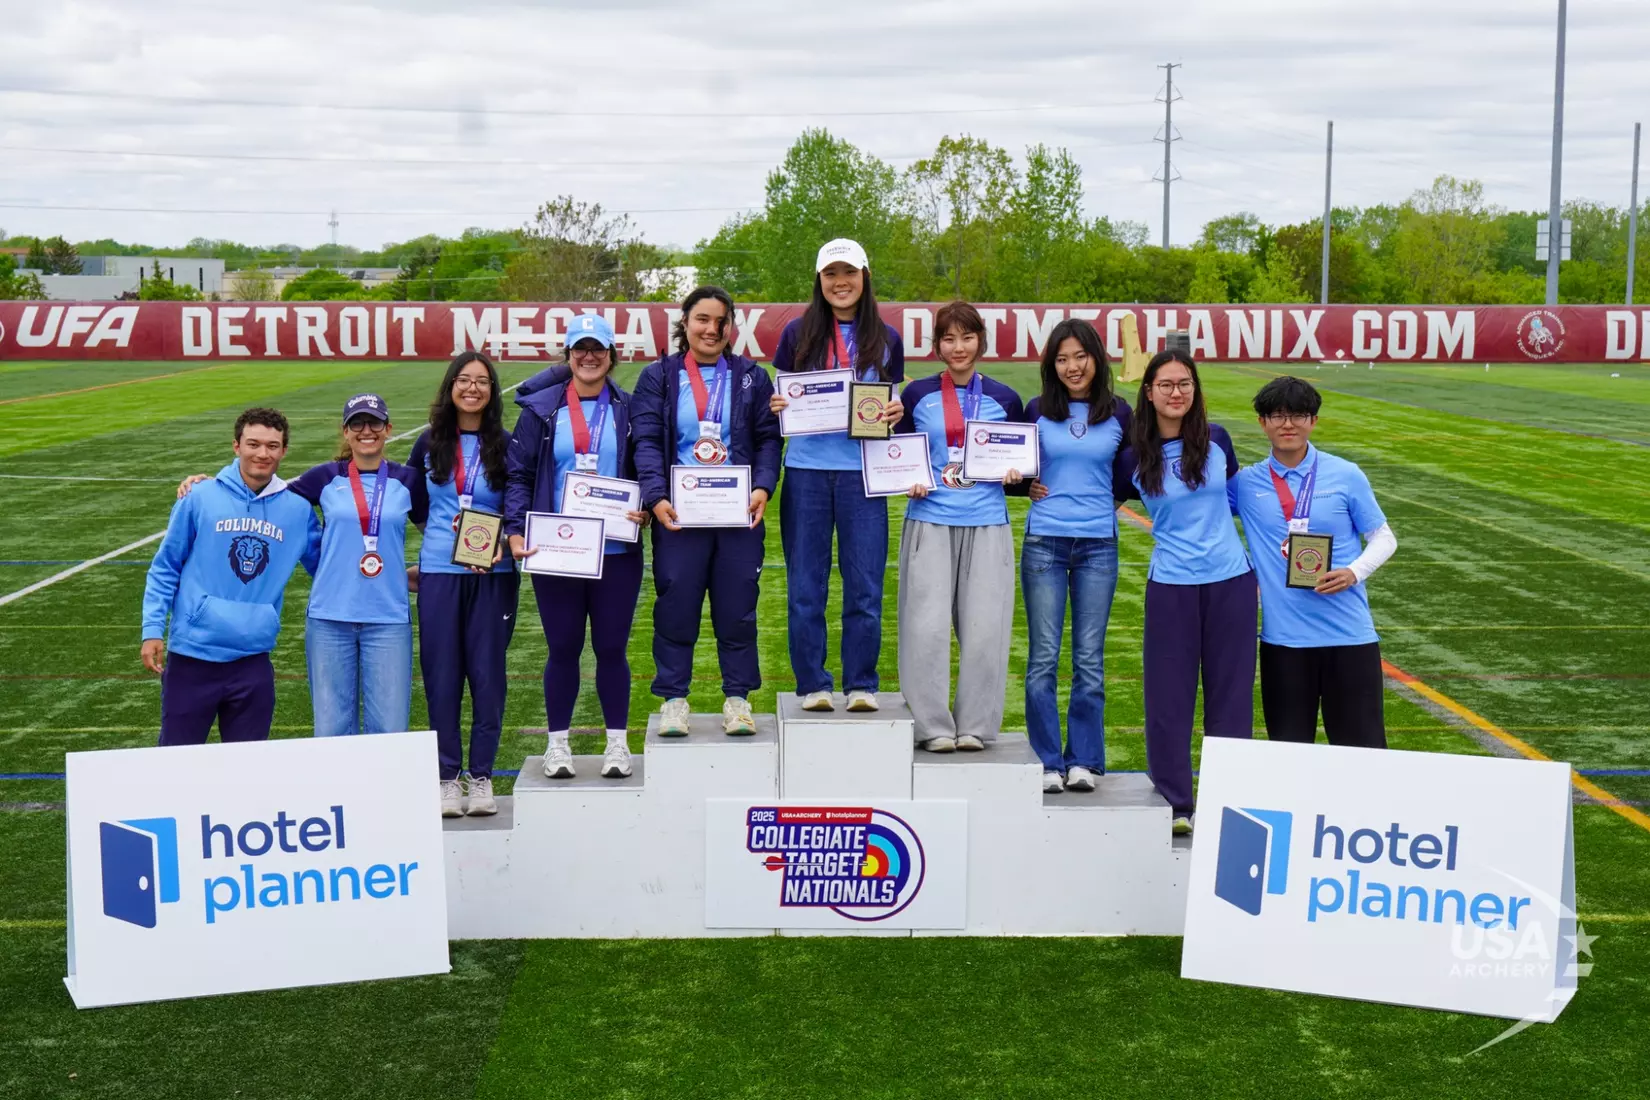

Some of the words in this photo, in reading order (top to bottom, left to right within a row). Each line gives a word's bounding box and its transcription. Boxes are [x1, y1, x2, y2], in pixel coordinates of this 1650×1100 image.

[15, 305, 140, 347] UFA
[181, 306, 425, 357] DETROIT
[582, 317, 594, 330] C
[1517, 311, 1542, 334] ADVANCED
[1543, 311, 1565, 334] TRAINING
[1605, 310, 1650, 360] D
[216, 518, 283, 541] COLUMBIA
[200, 805, 346, 859] hotel
[751, 811, 775, 822] 2025
[831, 812, 868, 820] hotelplanner
[751, 826, 866, 850] COLLEGIATE
[1312, 814, 1460, 871] hotel
[785, 852, 864, 877] TARGET
[203, 862, 419, 924] planner
[784, 880, 896, 904] NATIONALS
[1307, 869, 1532, 932] planner
